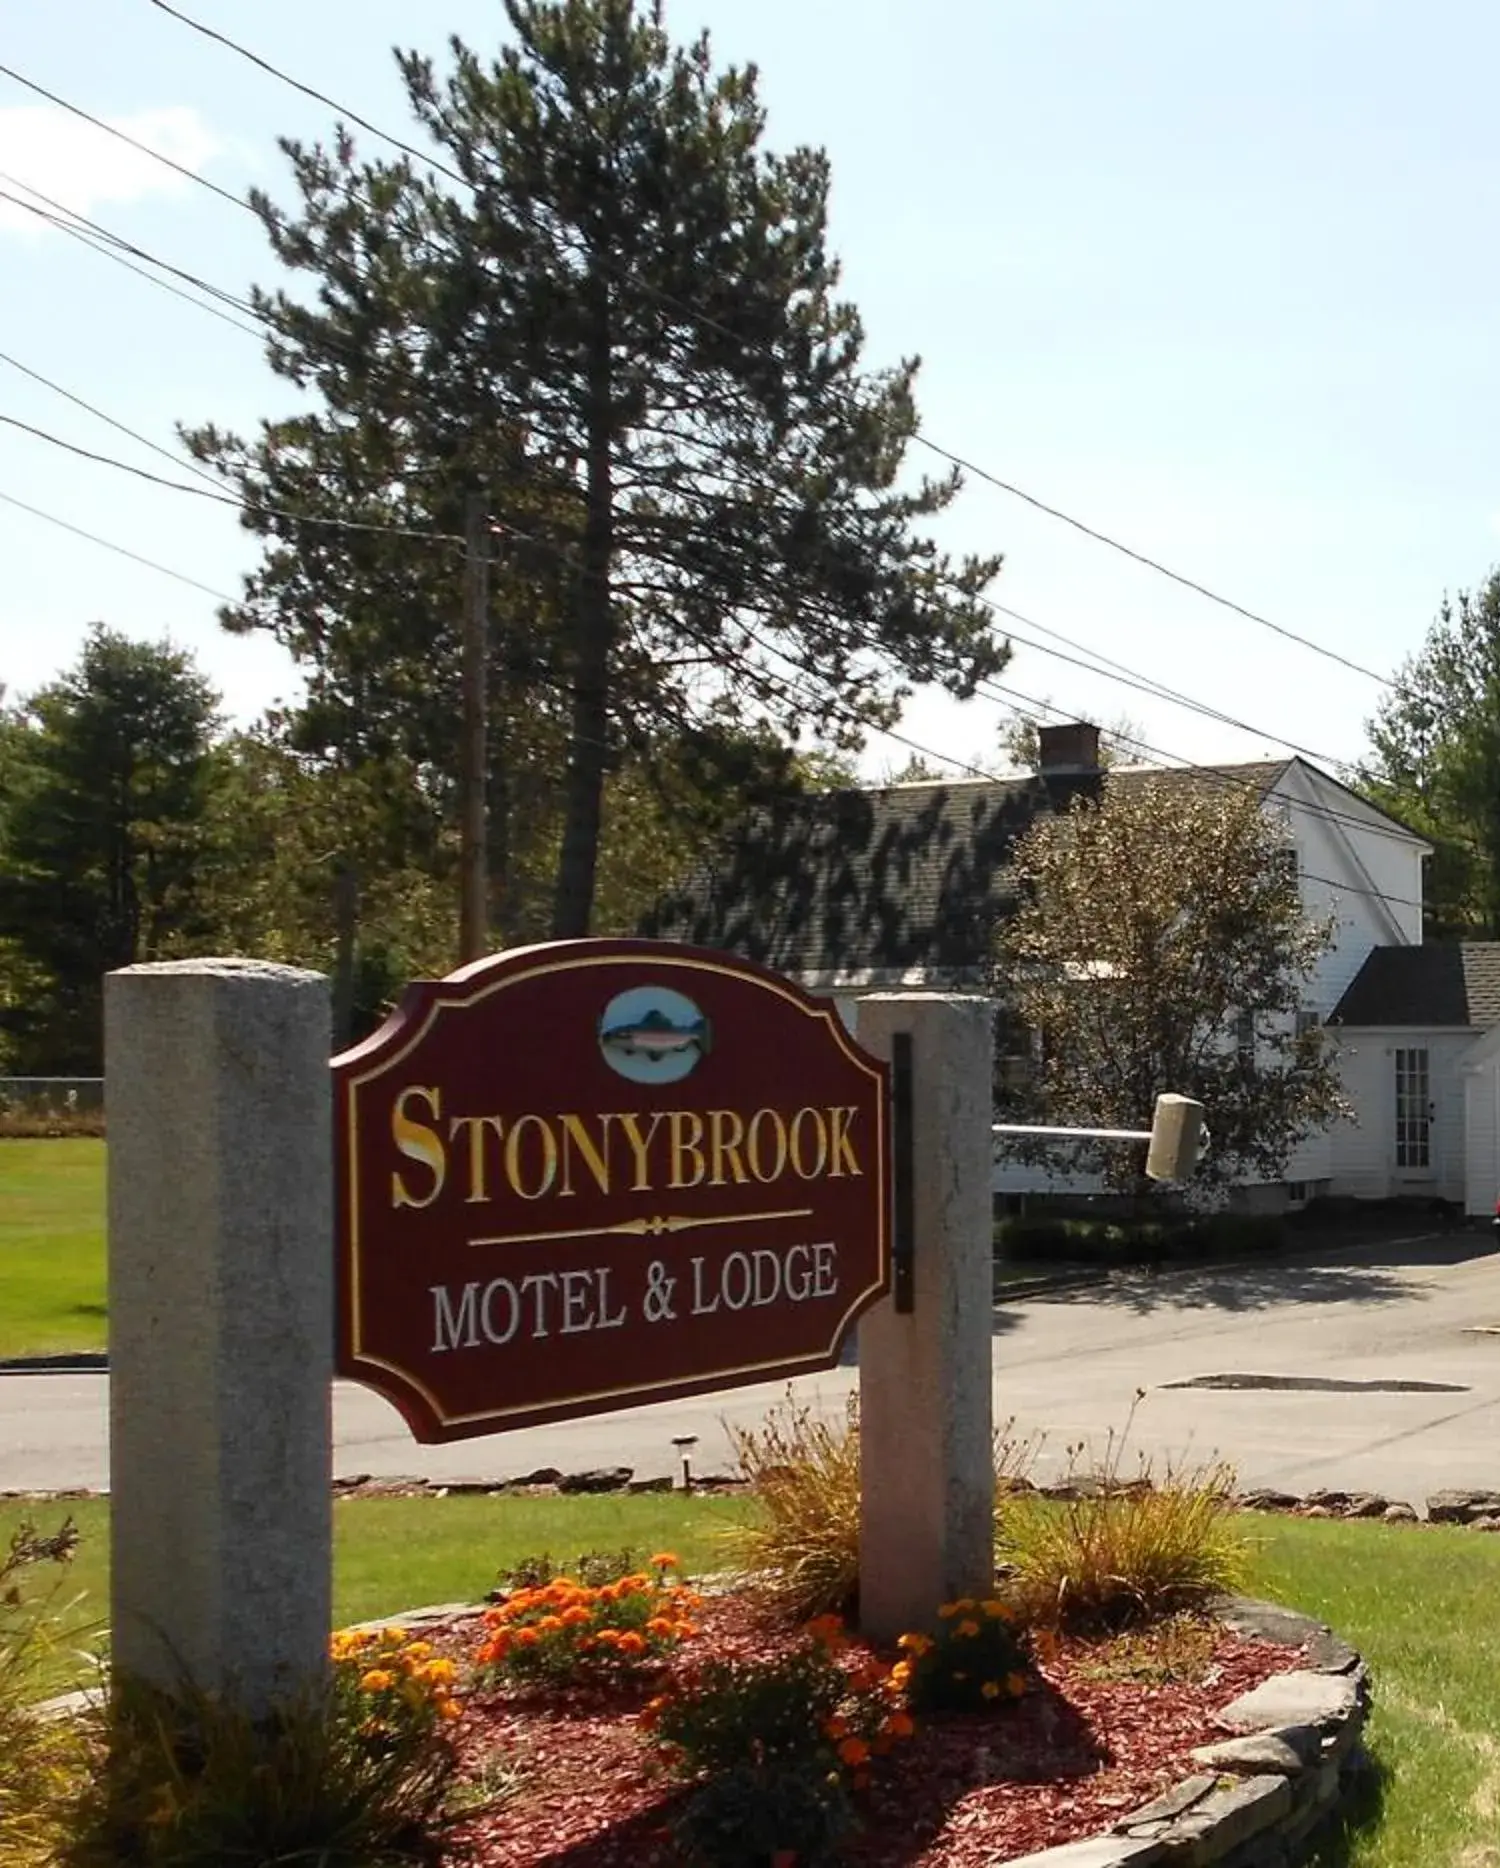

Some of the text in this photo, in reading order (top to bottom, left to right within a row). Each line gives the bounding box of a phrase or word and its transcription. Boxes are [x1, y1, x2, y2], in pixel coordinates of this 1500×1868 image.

[391, 1086, 863, 1209] STONYBROOK
[429, 1242, 838, 1353] MOTEL & LODGE
